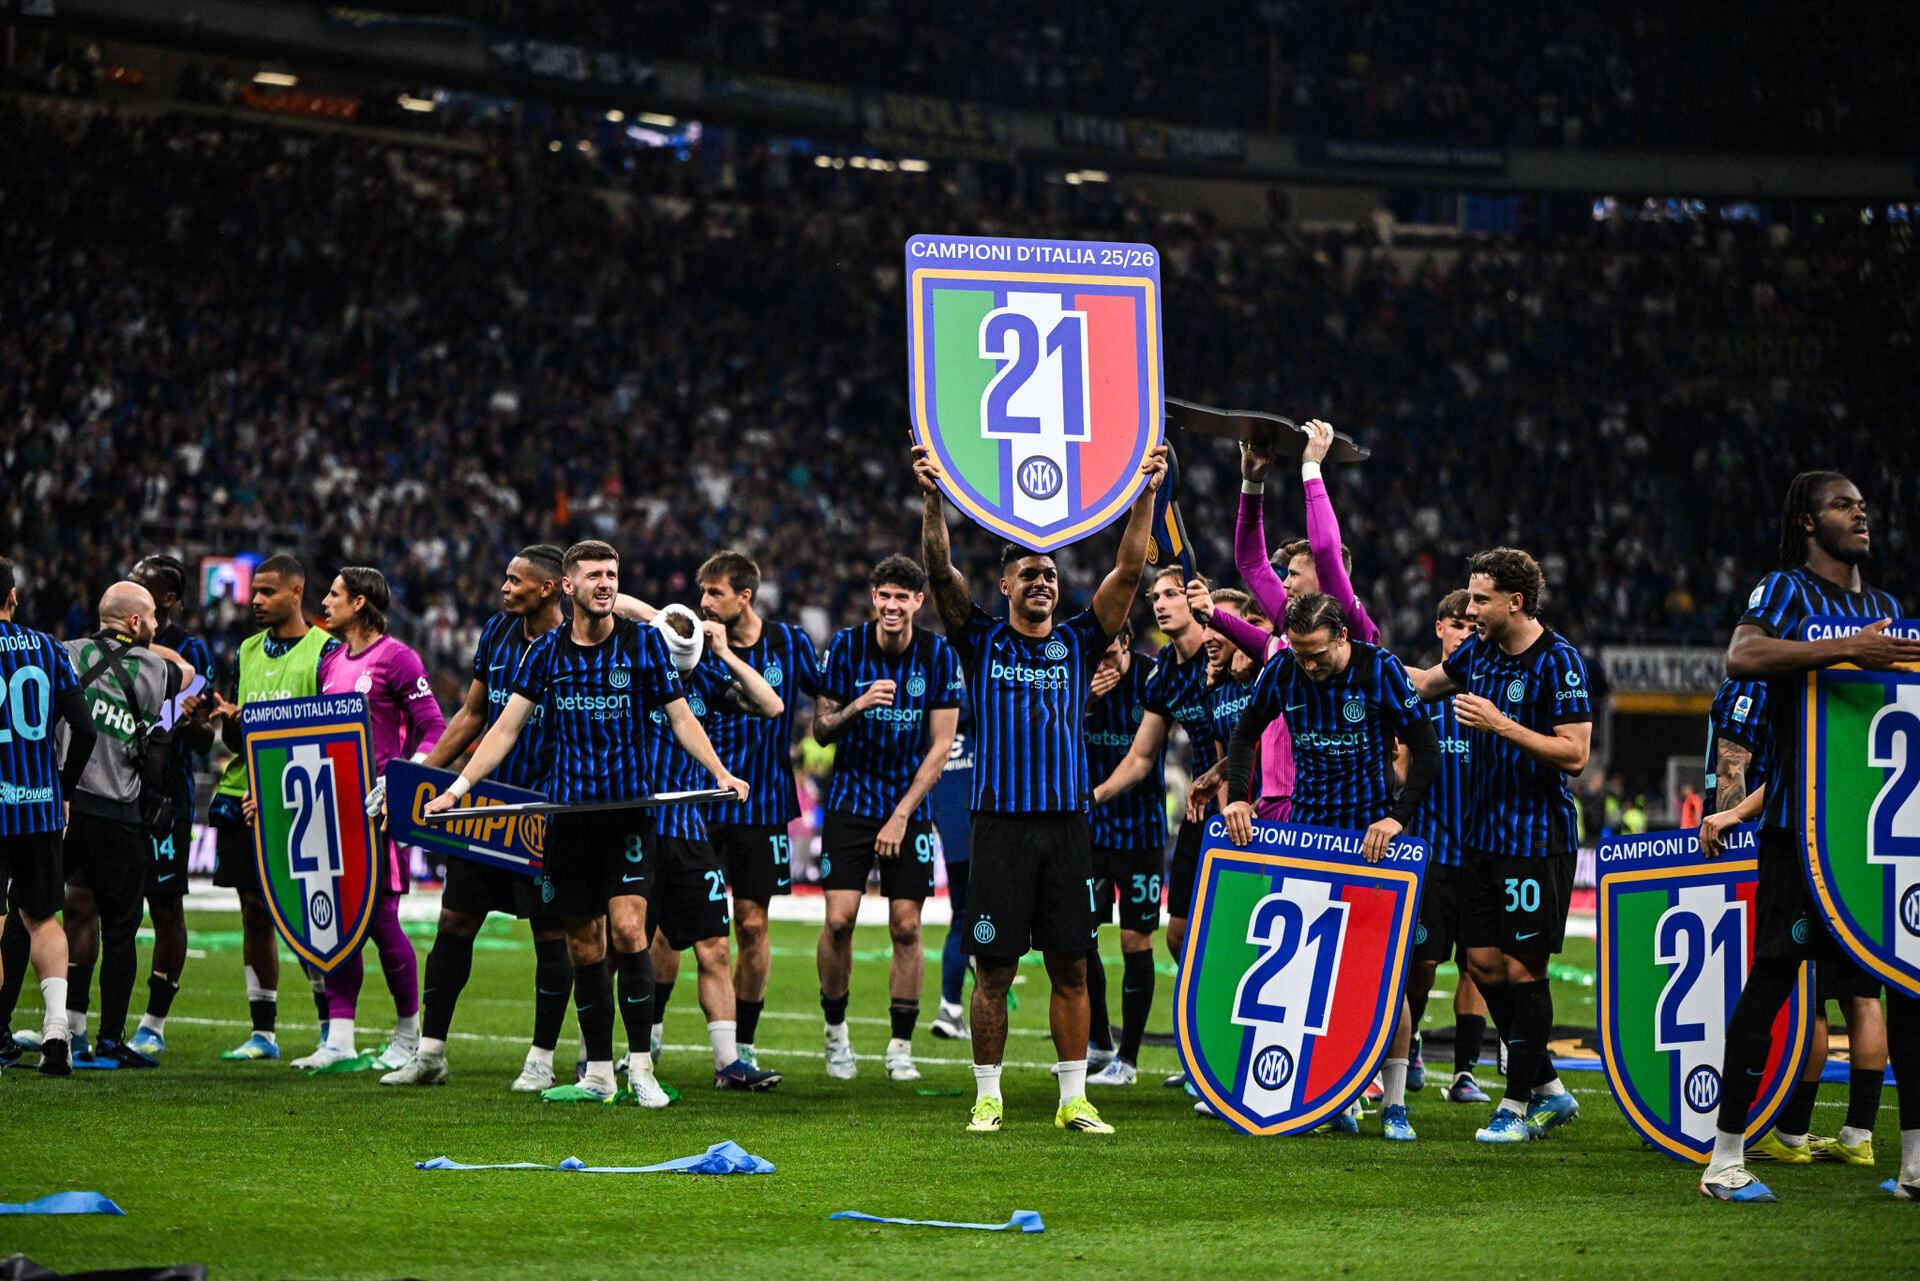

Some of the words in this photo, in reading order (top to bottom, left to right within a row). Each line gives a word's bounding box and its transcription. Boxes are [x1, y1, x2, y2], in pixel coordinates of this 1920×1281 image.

[911, 241, 1011, 261] CAMPIONI
[1100, 249, 1155, 269] 25/26
[984, 312, 1085, 436] 21
[0, 631, 41, 652] NOĞLU
[991, 659, 1068, 682] betsson
[1031, 679, 1068, 691] .sport
[243, 705, 292, 724] CAMPIONI
[335, 698, 363, 717] 25/26
[556, 691, 631, 711] betsson
[863, 706, 923, 722] etsson
[284, 764, 342, 874] 21
[624, 834, 643, 862] 8
[1208, 821, 1297, 847] CAPIONI
[1385, 842, 1424, 862] 5/26
[1600, 838, 1683, 862] CAMPIONI
[1131, 874, 1160, 904] 36
[1505, 878, 1541, 912] 30
[1237, 898, 1344, 1030] 21
[1659, 907, 1743, 1045] 21
